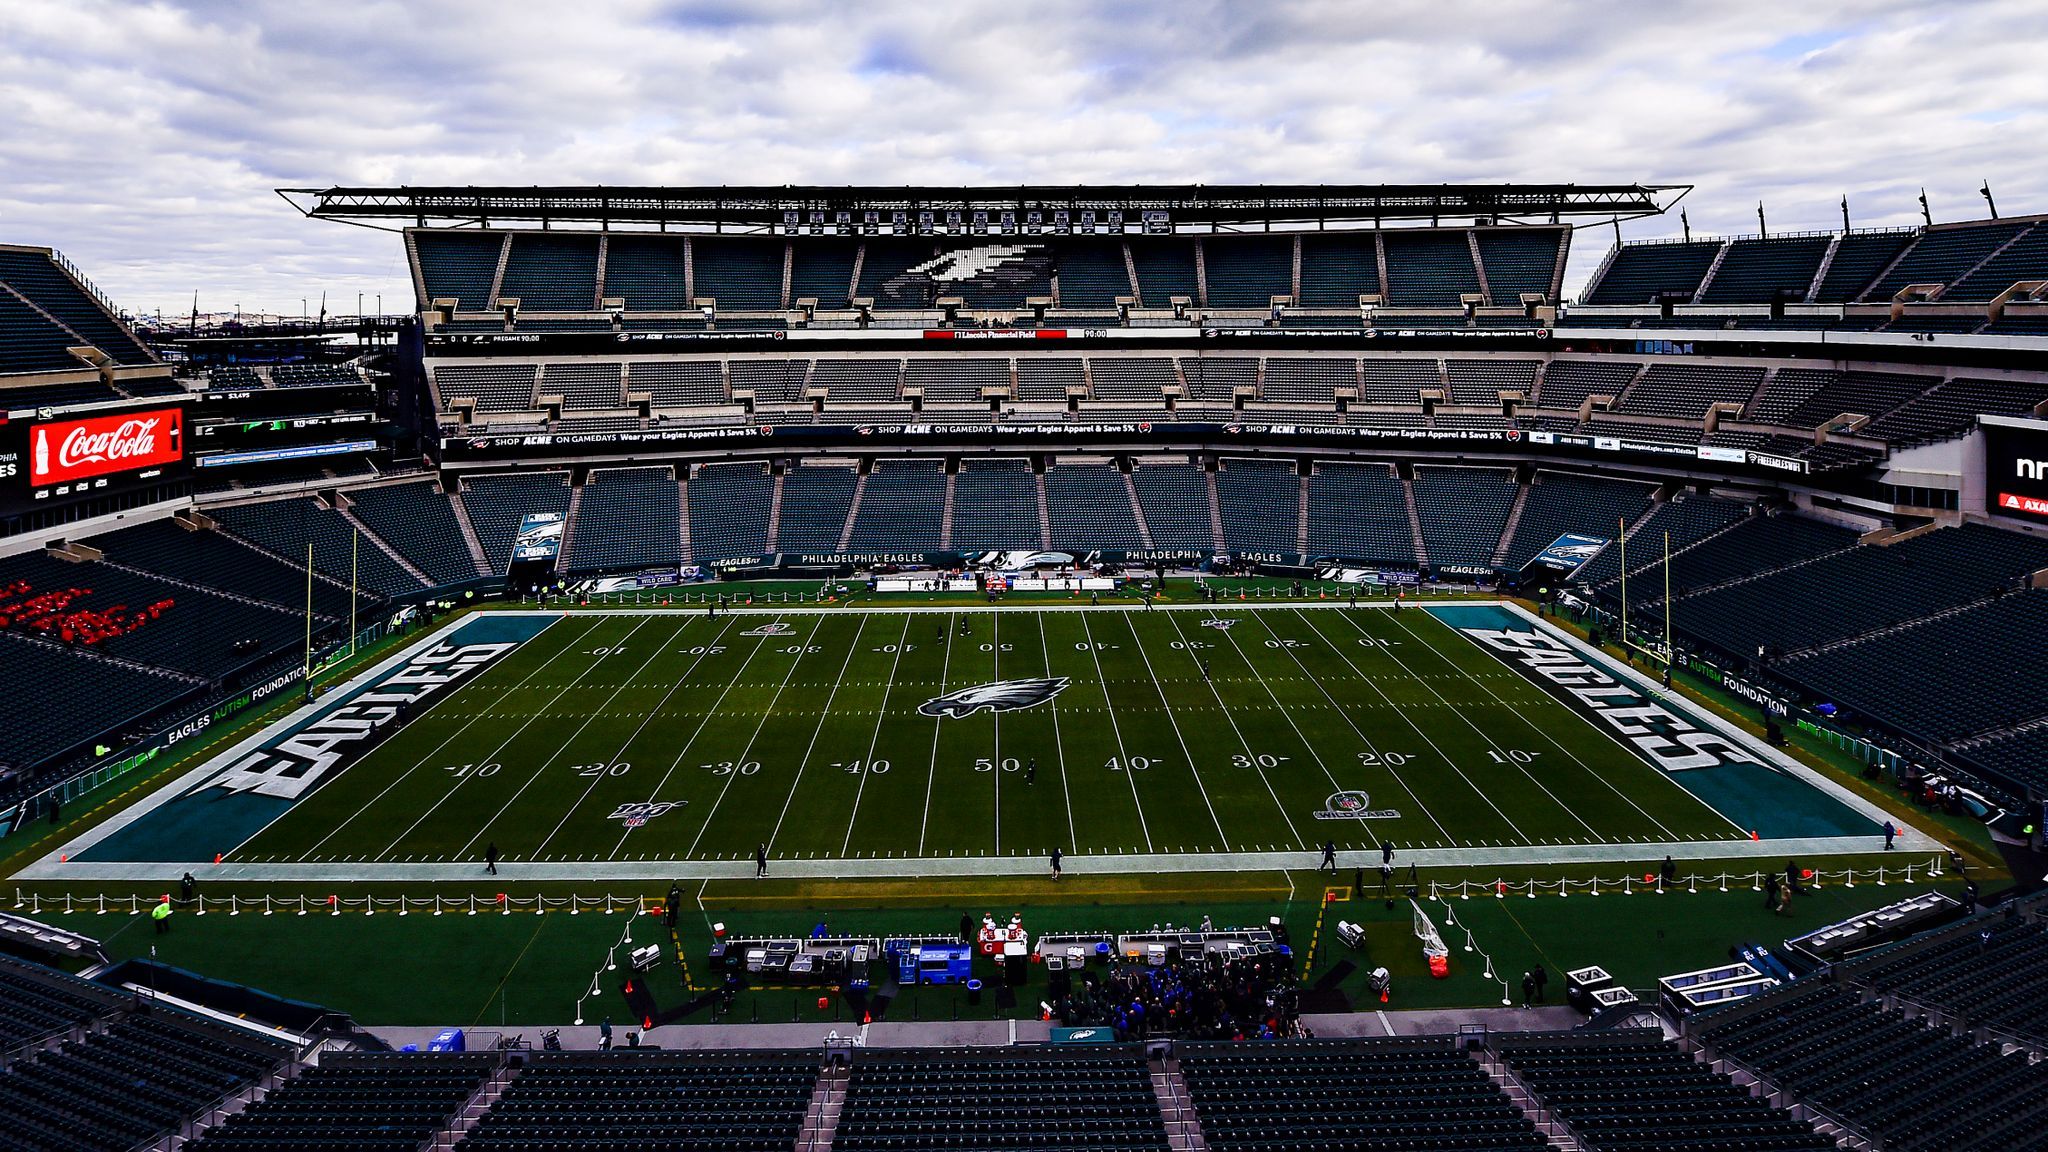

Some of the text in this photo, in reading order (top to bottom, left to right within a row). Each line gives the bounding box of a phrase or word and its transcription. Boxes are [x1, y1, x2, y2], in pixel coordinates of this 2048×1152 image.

[1018, 330, 1036, 338] Field
[1085, 330, 1106, 338] 90:00
[495, 438, 520, 446] SHOP
[523, 435, 553, 446] ACME
[571, 434, 617, 443] GAMEDAYS
[620, 433, 641, 441] Wear
[662, 431, 687, 441] Eagles
[687, 430, 718, 438] Apparel
[745, 428, 757, 436] 5%
[878, 426, 901, 434] SHOP
[903, 425, 932, 434] ACME
[949, 425, 993, 433] GAMEDAYS
[1037, 425, 1062, 434] Eagles
[1063, 425, 1094, 434] Apparel
[1270, 425, 1296, 434] ACME
[1313, 427, 1356, 435] GAMEDAYS
[1360, 428, 1379, 436] Wear
[1380, 430, 1399, 438] your
[1400, 430, 1426, 439] Eagles
[1427, 430, 1459, 439] Apparel
[1489, 432, 1502, 440] 5%
[59, 417, 160, 467] Coca-Cola
[720, 558, 751, 567] EAGLES
[802, 553, 924, 563] PHILADELPHIA EAGLES
[1126, 550, 1202, 560] PHILADELPHIA
[1241, 551, 1282, 562] EAGLES
[1450, 566, 1485, 575] EAGLES
[1689, 659, 1721, 683] AUTISM
[1723, 676, 1788, 717] FOUNDATION
[1458, 626, 1783, 771] EAGLES
[168, 714, 210, 745] EAGLES
[213, 695, 250, 721] AUTISM
[182, 641, 518, 800] EAGLES
[1104, 756, 1150, 771] 40
[1231, 753, 1278, 768] 30
[1357, 751, 1407, 767] 20
[1486, 749, 1534, 764] 10
[452, 763, 502, 778] 10
[578, 762, 631, 777] 20
[712, 761, 761, 776] 30
[843, 760, 891, 774] 40
[973, 758, 1021, 772] 50
[983, 943, 993, 952] G
